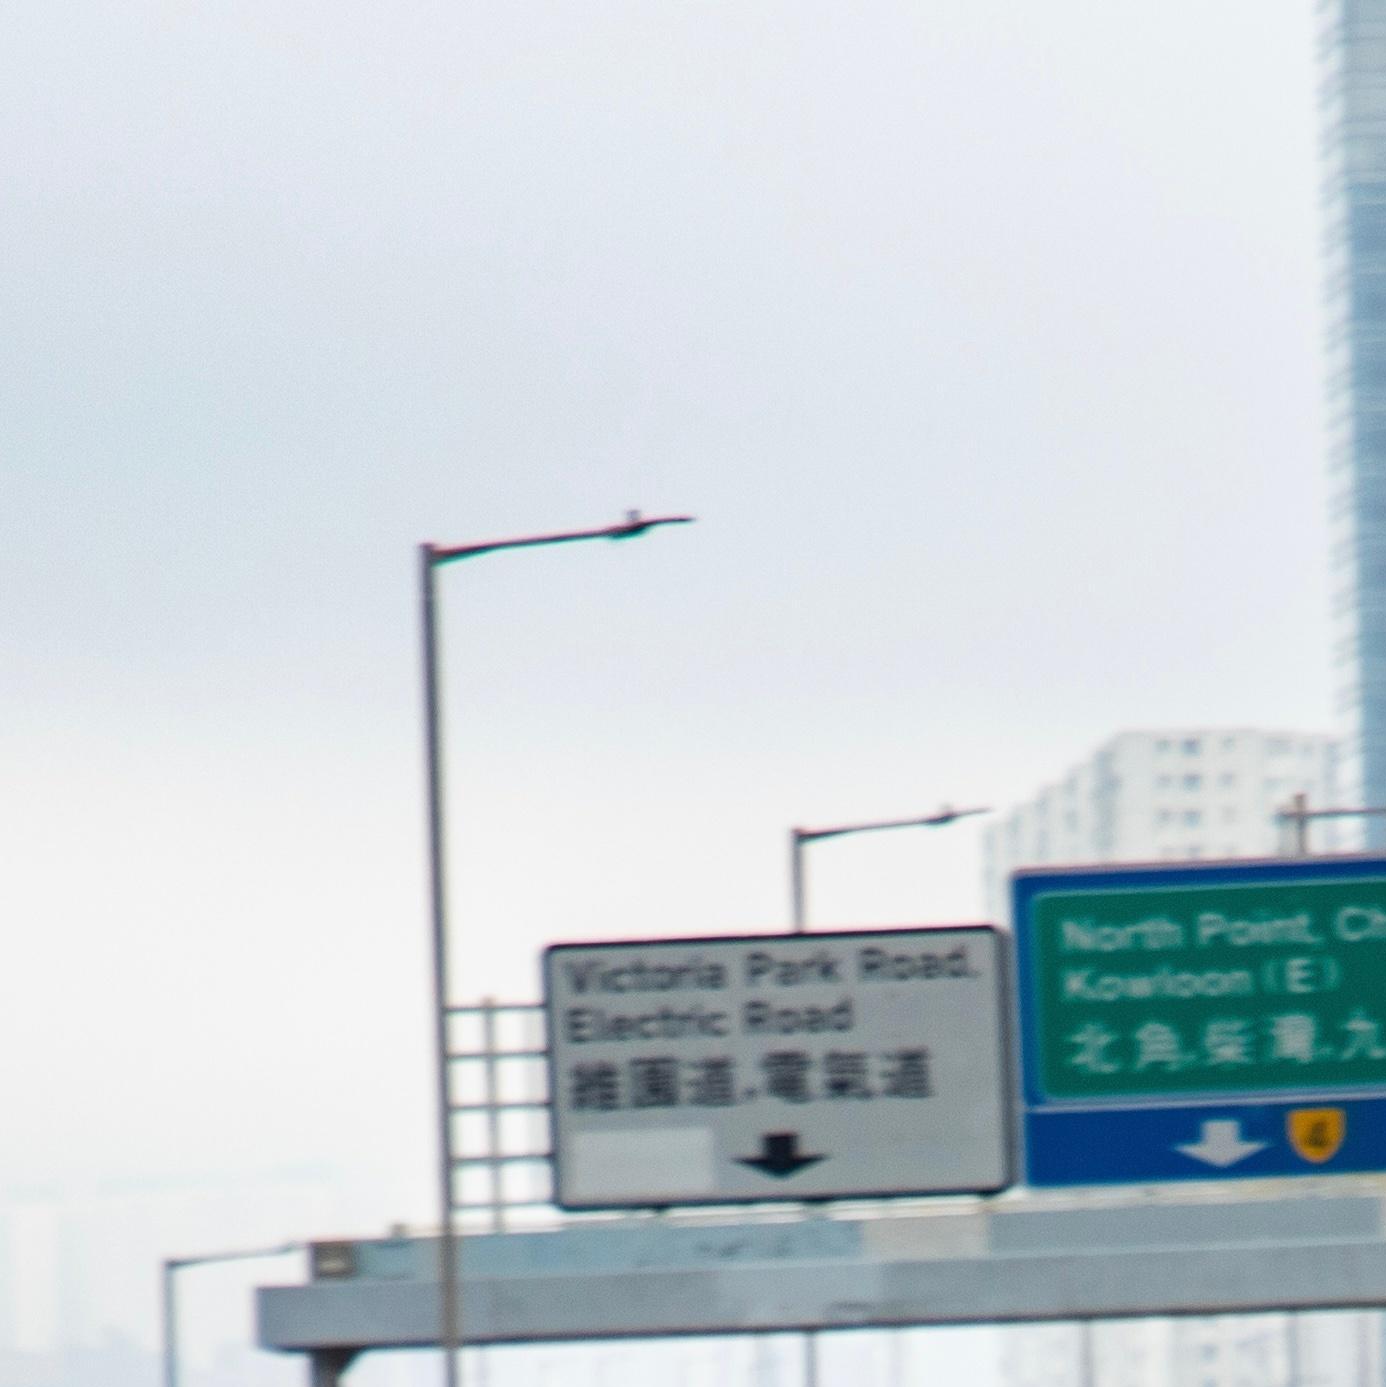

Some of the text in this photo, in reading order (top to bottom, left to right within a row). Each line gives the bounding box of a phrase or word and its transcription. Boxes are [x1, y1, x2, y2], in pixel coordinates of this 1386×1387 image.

[1061, 918, 1183, 952] North
[566, 955, 727, 994] Victoria
[745, 951, 840, 987] Park
[1064, 965, 1252, 1001] Kowloon
[566, 998, 854, 1043] Electric Road
